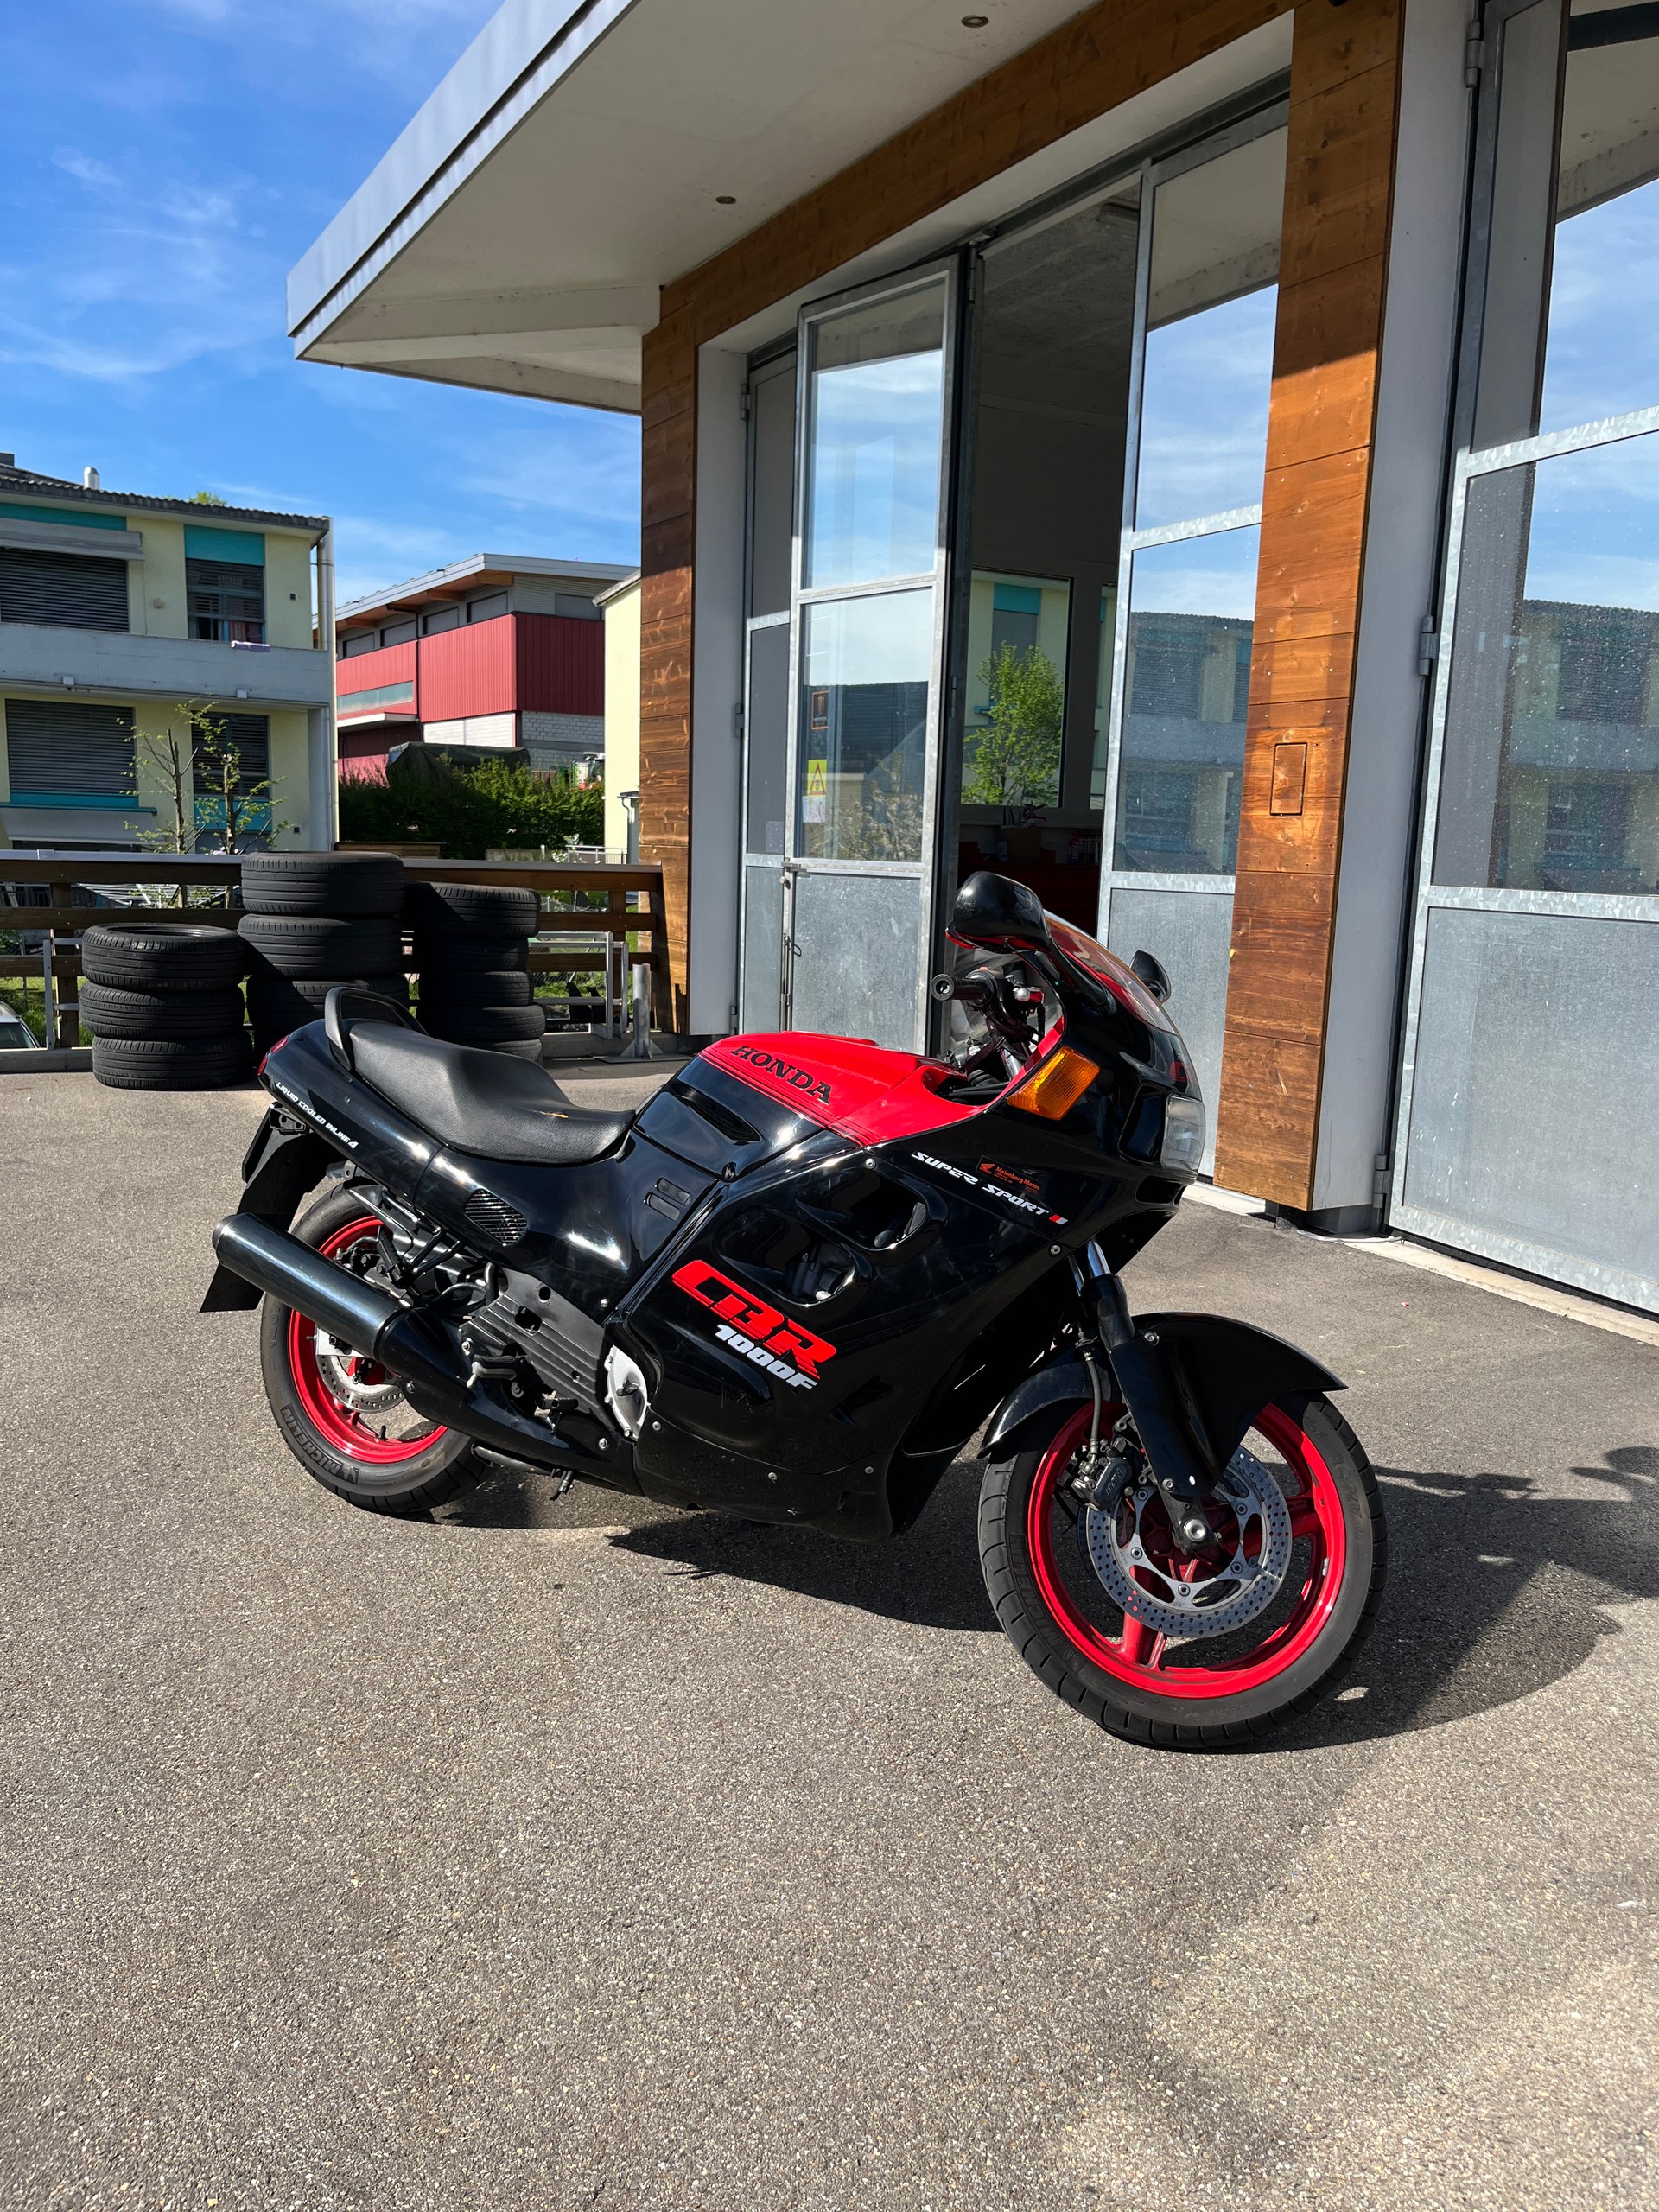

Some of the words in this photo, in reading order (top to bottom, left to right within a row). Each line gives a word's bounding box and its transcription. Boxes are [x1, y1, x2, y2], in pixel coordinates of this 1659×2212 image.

[731, 1045, 832, 1105] HONDA
[276, 1081, 299, 1103] LIQUID
[298, 1100, 327, 1125] COOLED
[325, 1122, 351, 1143] INLINE
[347, 1141, 359, 1149] 4
[911, 1151, 979, 1185] SUPER
[982, 1183, 1050, 1216] SPORT
[671, 1259, 836, 1380] CBR
[715, 1324, 818, 1389] 1000F
[282, 1408, 341, 1476] MICHELIN
[1010, 1535, 1064, 1647] MICHELIN
